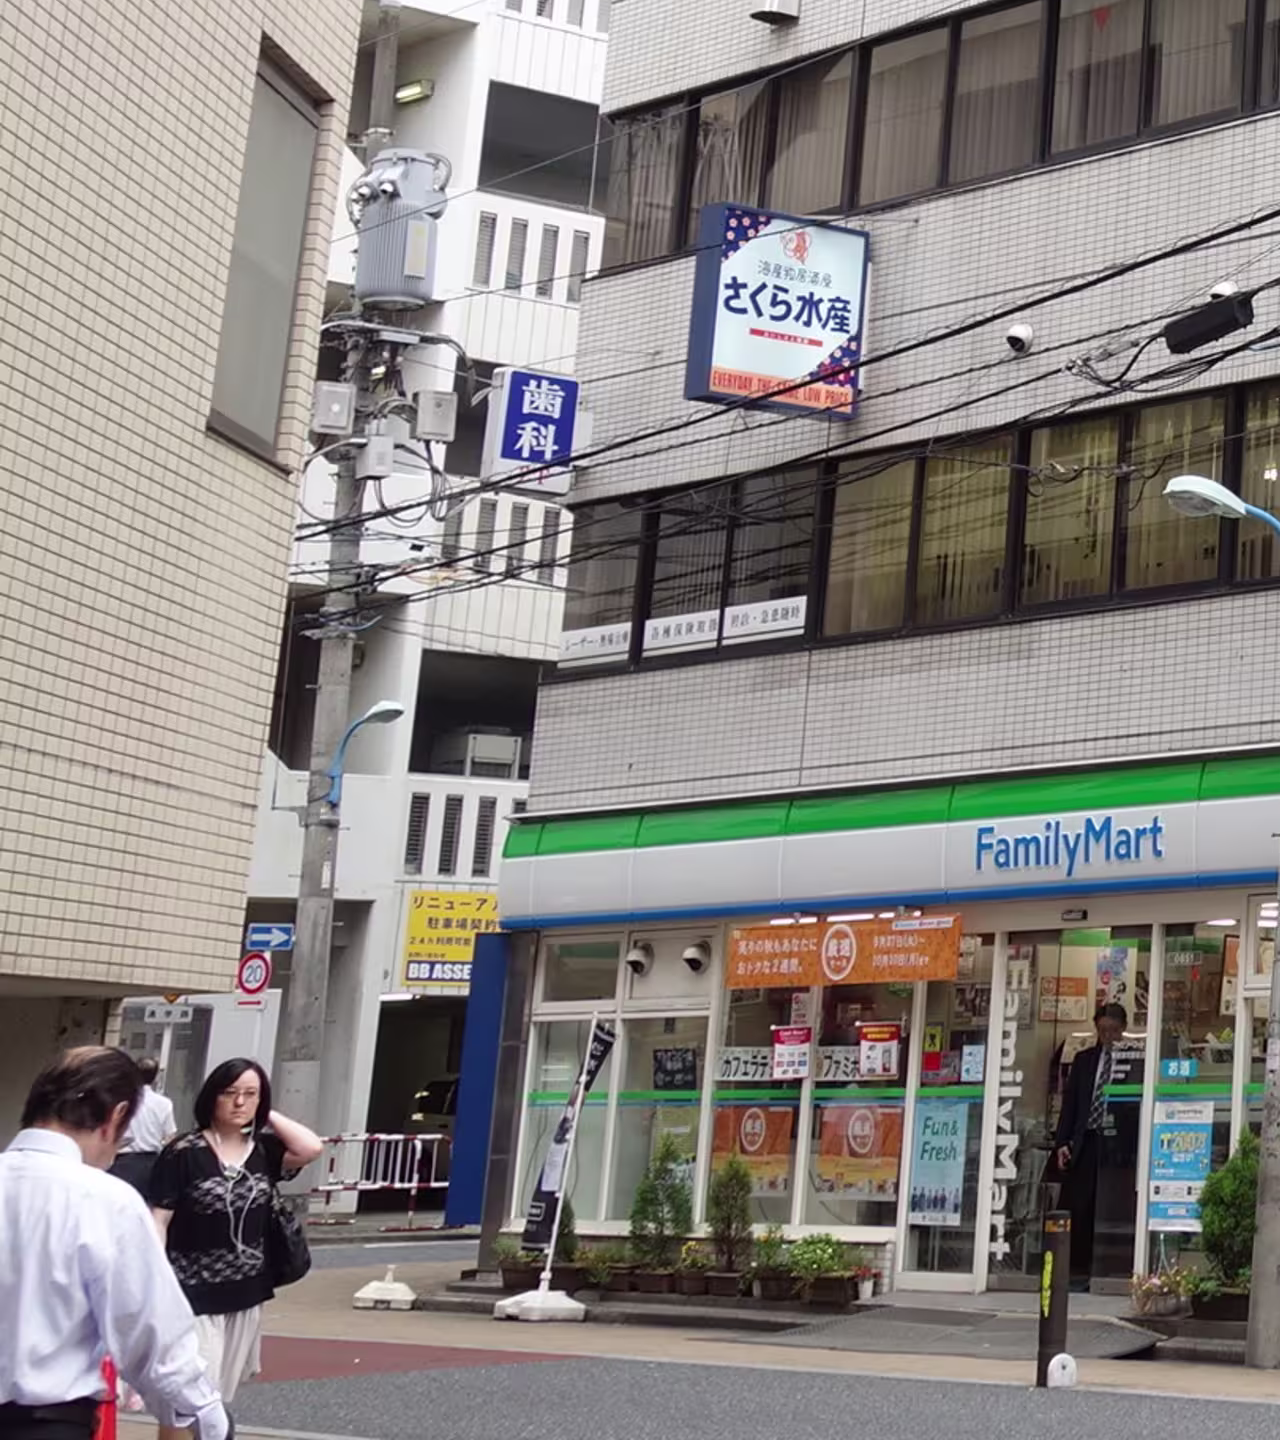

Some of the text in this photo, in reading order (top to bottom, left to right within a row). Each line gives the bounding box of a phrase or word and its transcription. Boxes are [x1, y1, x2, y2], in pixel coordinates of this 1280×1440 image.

[723, 276, 852, 334] さくら水産
[713, 370, 754, 391] EVERYDAY
[803, 386, 821, 401] LOW
[514, 378, 567, 460] 歯科
[976, 816, 1163, 878] FamilyMart
[245, 965, 263, 983] 20
[408, 963, 472, 979] BB ASSE
[920, 1141, 958, 1161] Fresh
